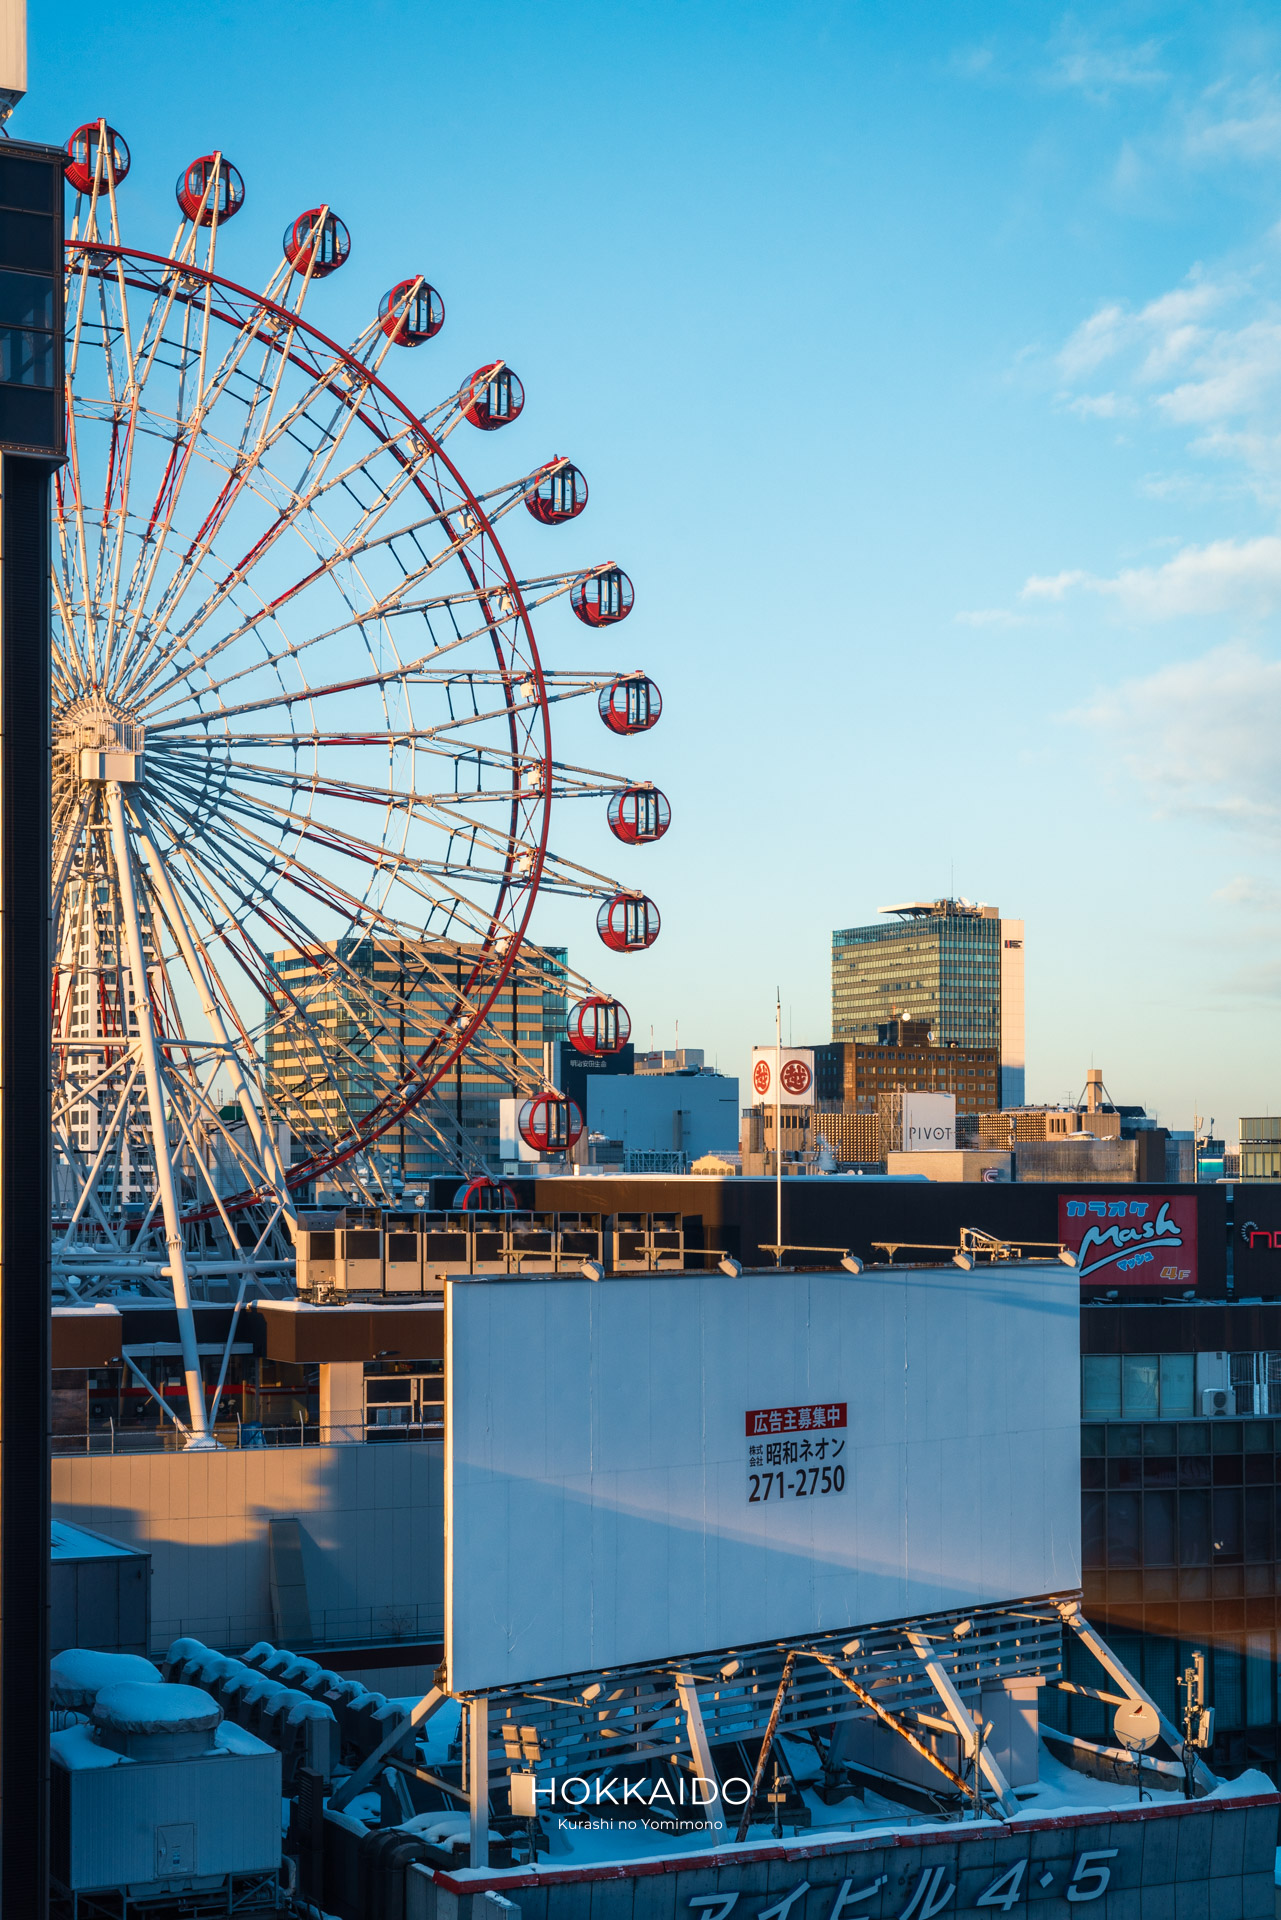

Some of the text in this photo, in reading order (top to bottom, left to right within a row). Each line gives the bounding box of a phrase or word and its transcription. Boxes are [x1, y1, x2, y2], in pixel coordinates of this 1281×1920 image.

[909, 1127, 952, 1140] PIVOT
[1066, 1201, 1149, 1217] カラオケ
[1079, 1201, 1181, 1270] Mash
[1117, 1251, 1155, 1271] マッシュ
[1160, 1266, 1191, 1280] 4F
[753, 1406, 840, 1433] 広告主募集中
[766, 1437, 845, 1466] 昭和ネオン
[748, 1465, 845, 1503] 271-2750
